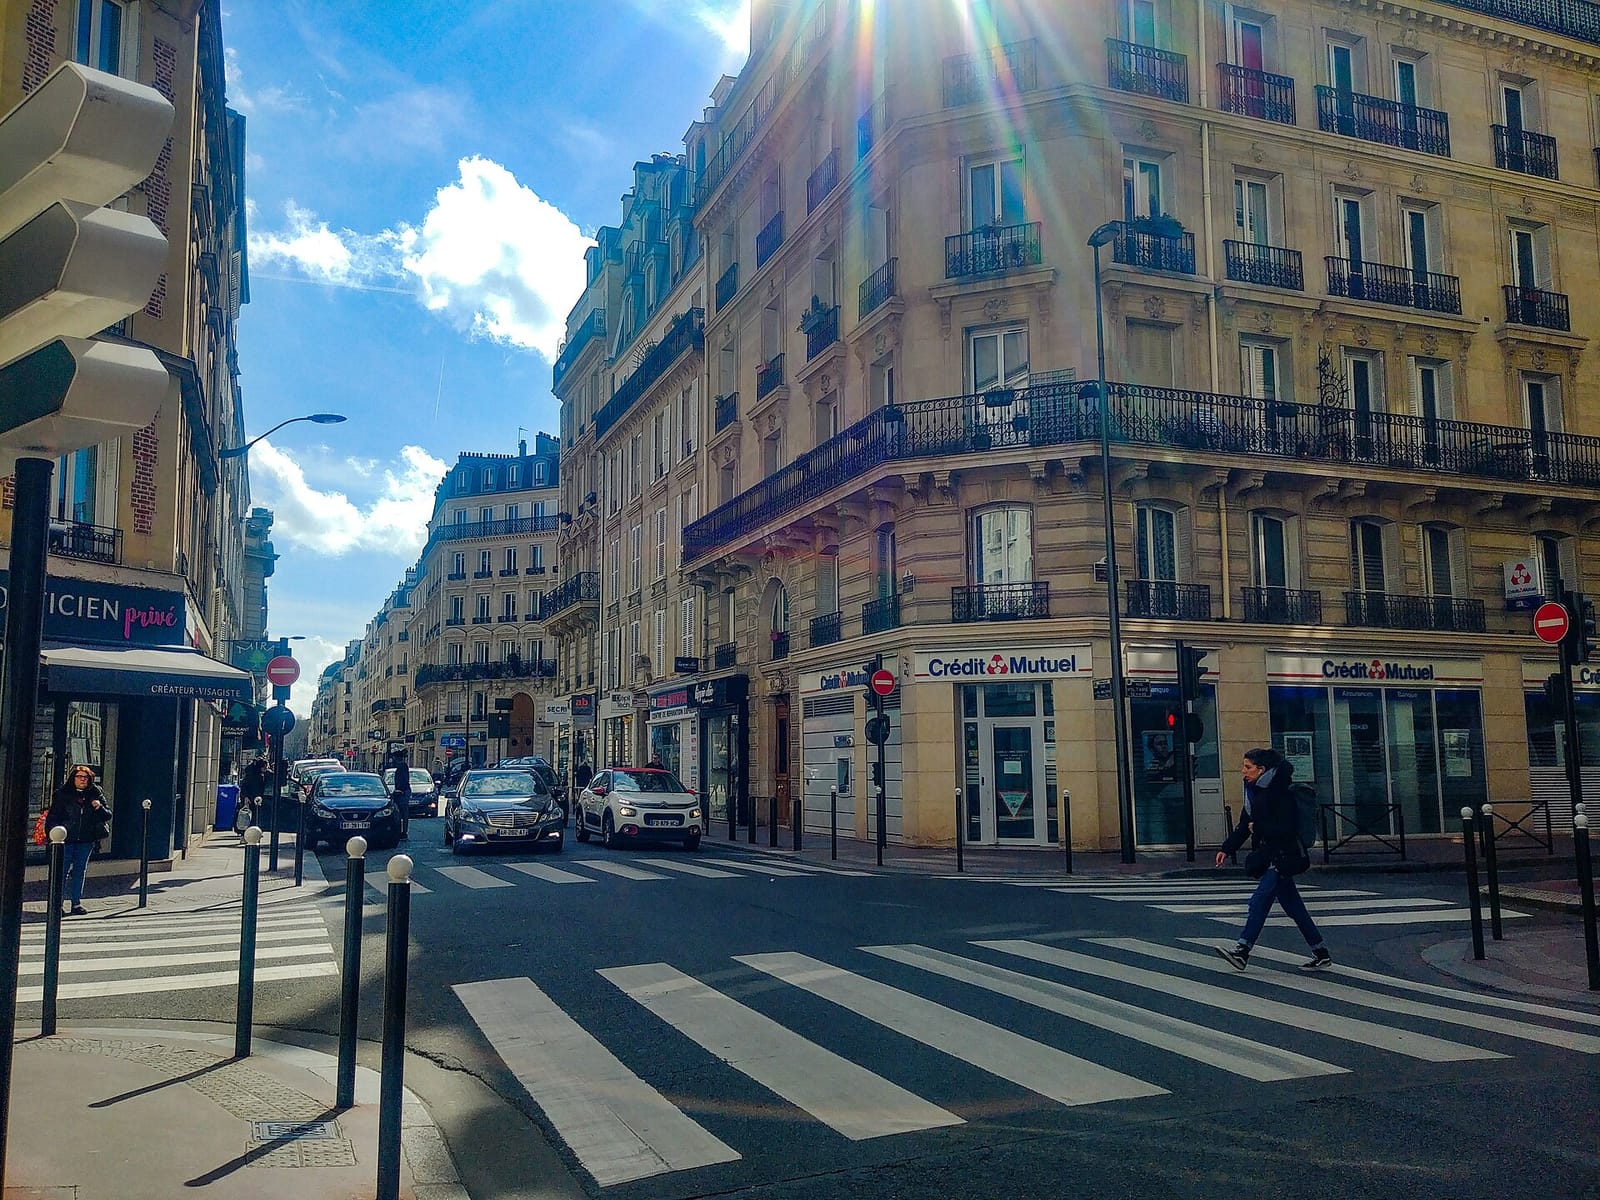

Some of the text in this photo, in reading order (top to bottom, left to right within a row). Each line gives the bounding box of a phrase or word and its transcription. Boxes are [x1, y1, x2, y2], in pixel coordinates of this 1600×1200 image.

[124, 604, 178, 639] privé
[928, 654, 1076, 677] Crédit Mutuel
[1322, 660, 1434, 681] Crédit Mutuel
[1580, 667, 1600, 685] Cré
[150, 683, 242, 698] CRÉATEUR-VISAGISTE
